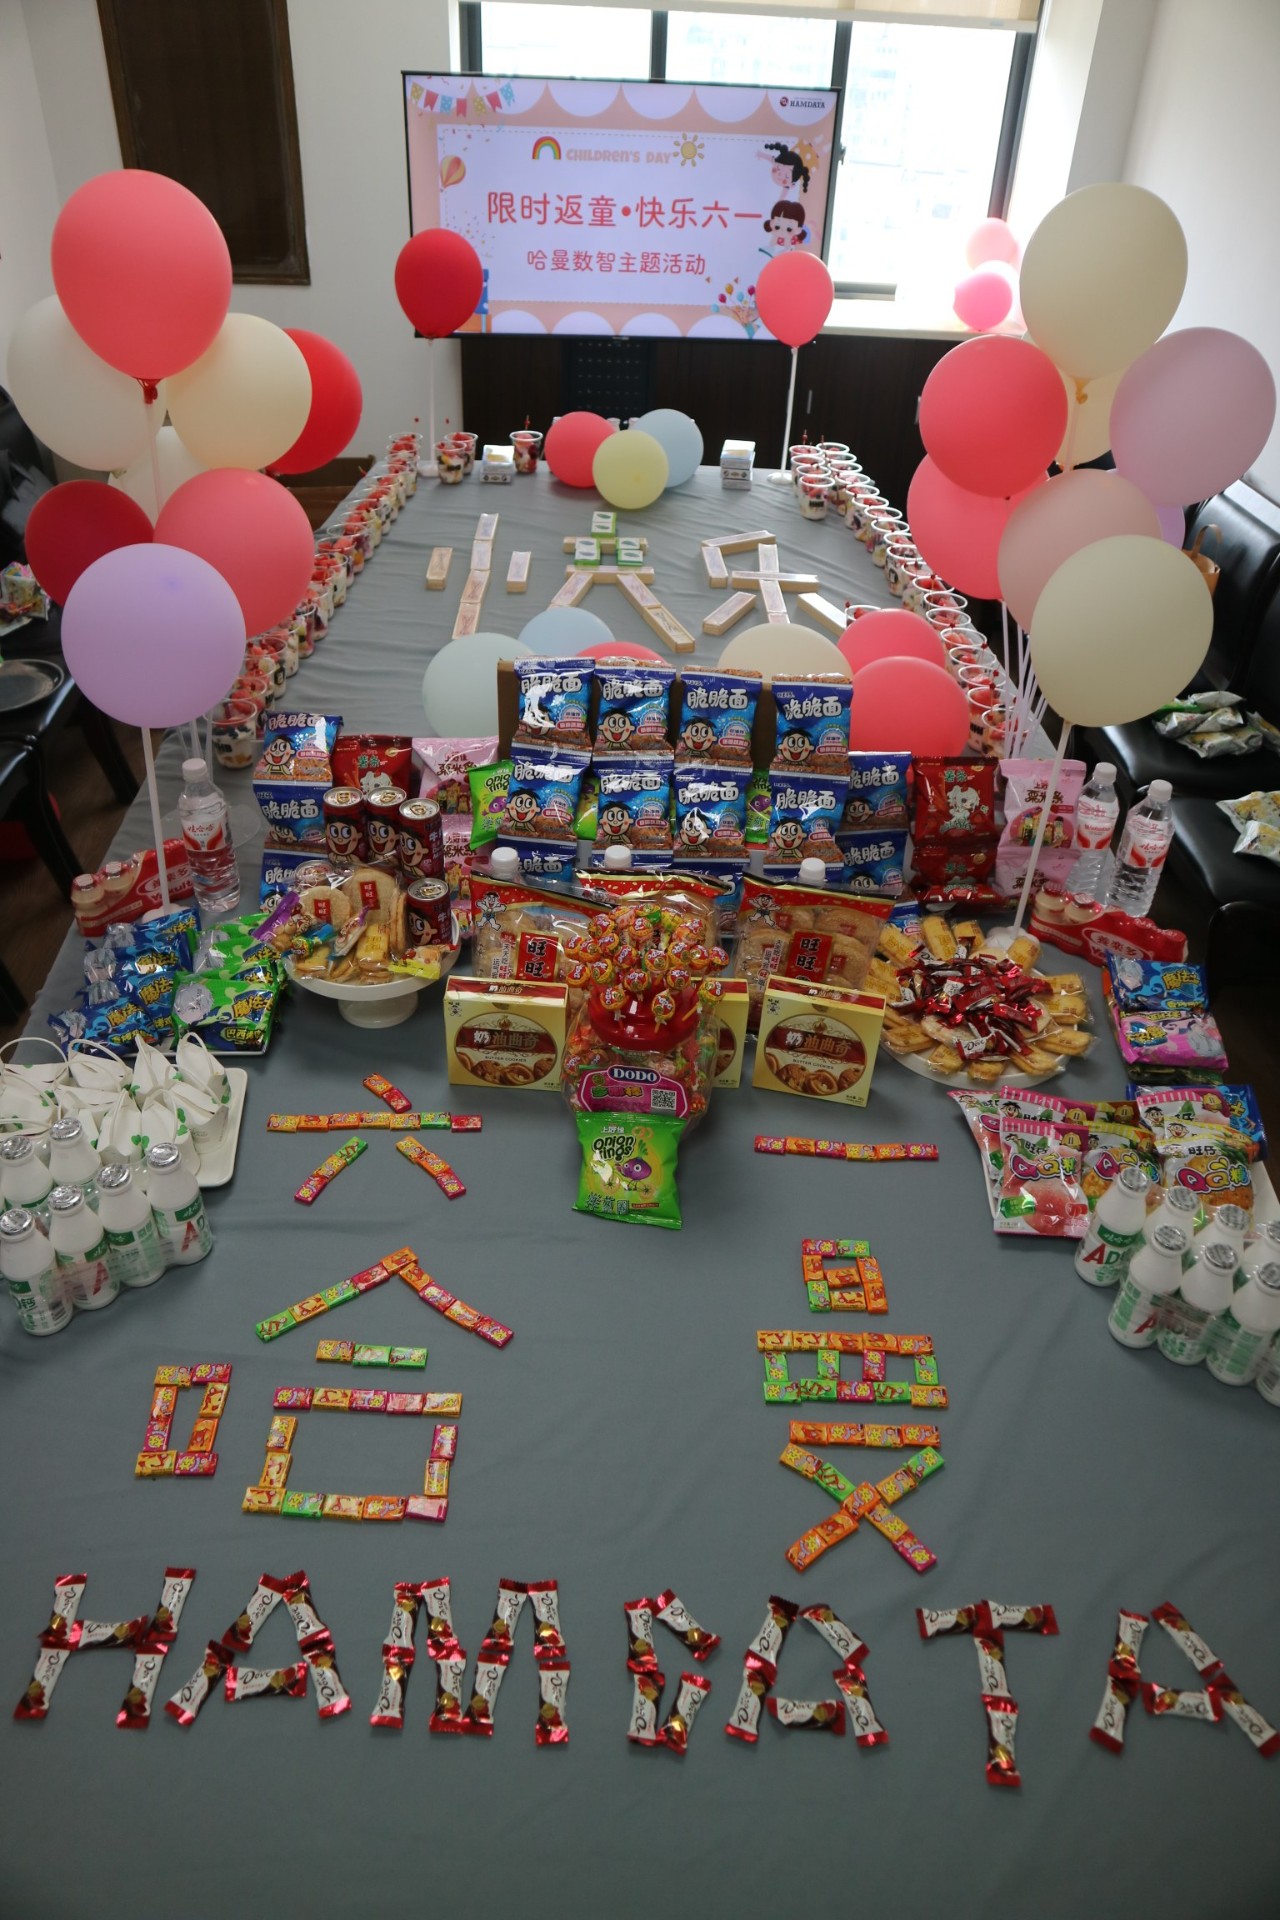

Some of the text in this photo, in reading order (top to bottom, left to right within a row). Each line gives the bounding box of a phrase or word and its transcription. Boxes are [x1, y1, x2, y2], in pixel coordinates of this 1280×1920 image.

[789, 100, 826, 109] HAMDATA
[645, 152, 673, 165] DAY
[526, 249, 706, 276] 哈曼数智主题活动
[687, 688, 748, 709] 脆脆面
[784, 696, 842, 720] 脆脆面
[263, 799, 319, 820] 脆脆面
[776, 790, 836, 811] 脆脆面
[187, 823, 214, 833] 娃哈哈
[525, 939, 547, 977] 旺旺
[796, 937, 822, 971] 旺旺
[473, 1030, 540, 1048] 奶油曲奇
[785, 1031, 852, 1055] 奶油曲奇
[964, 1037, 985, 1050] Dove
[613, 1068, 658, 1082] DODO
[1188, 1145, 1216, 1156] 旺仔
[1177, 1157, 1250, 1193] QQ糖
